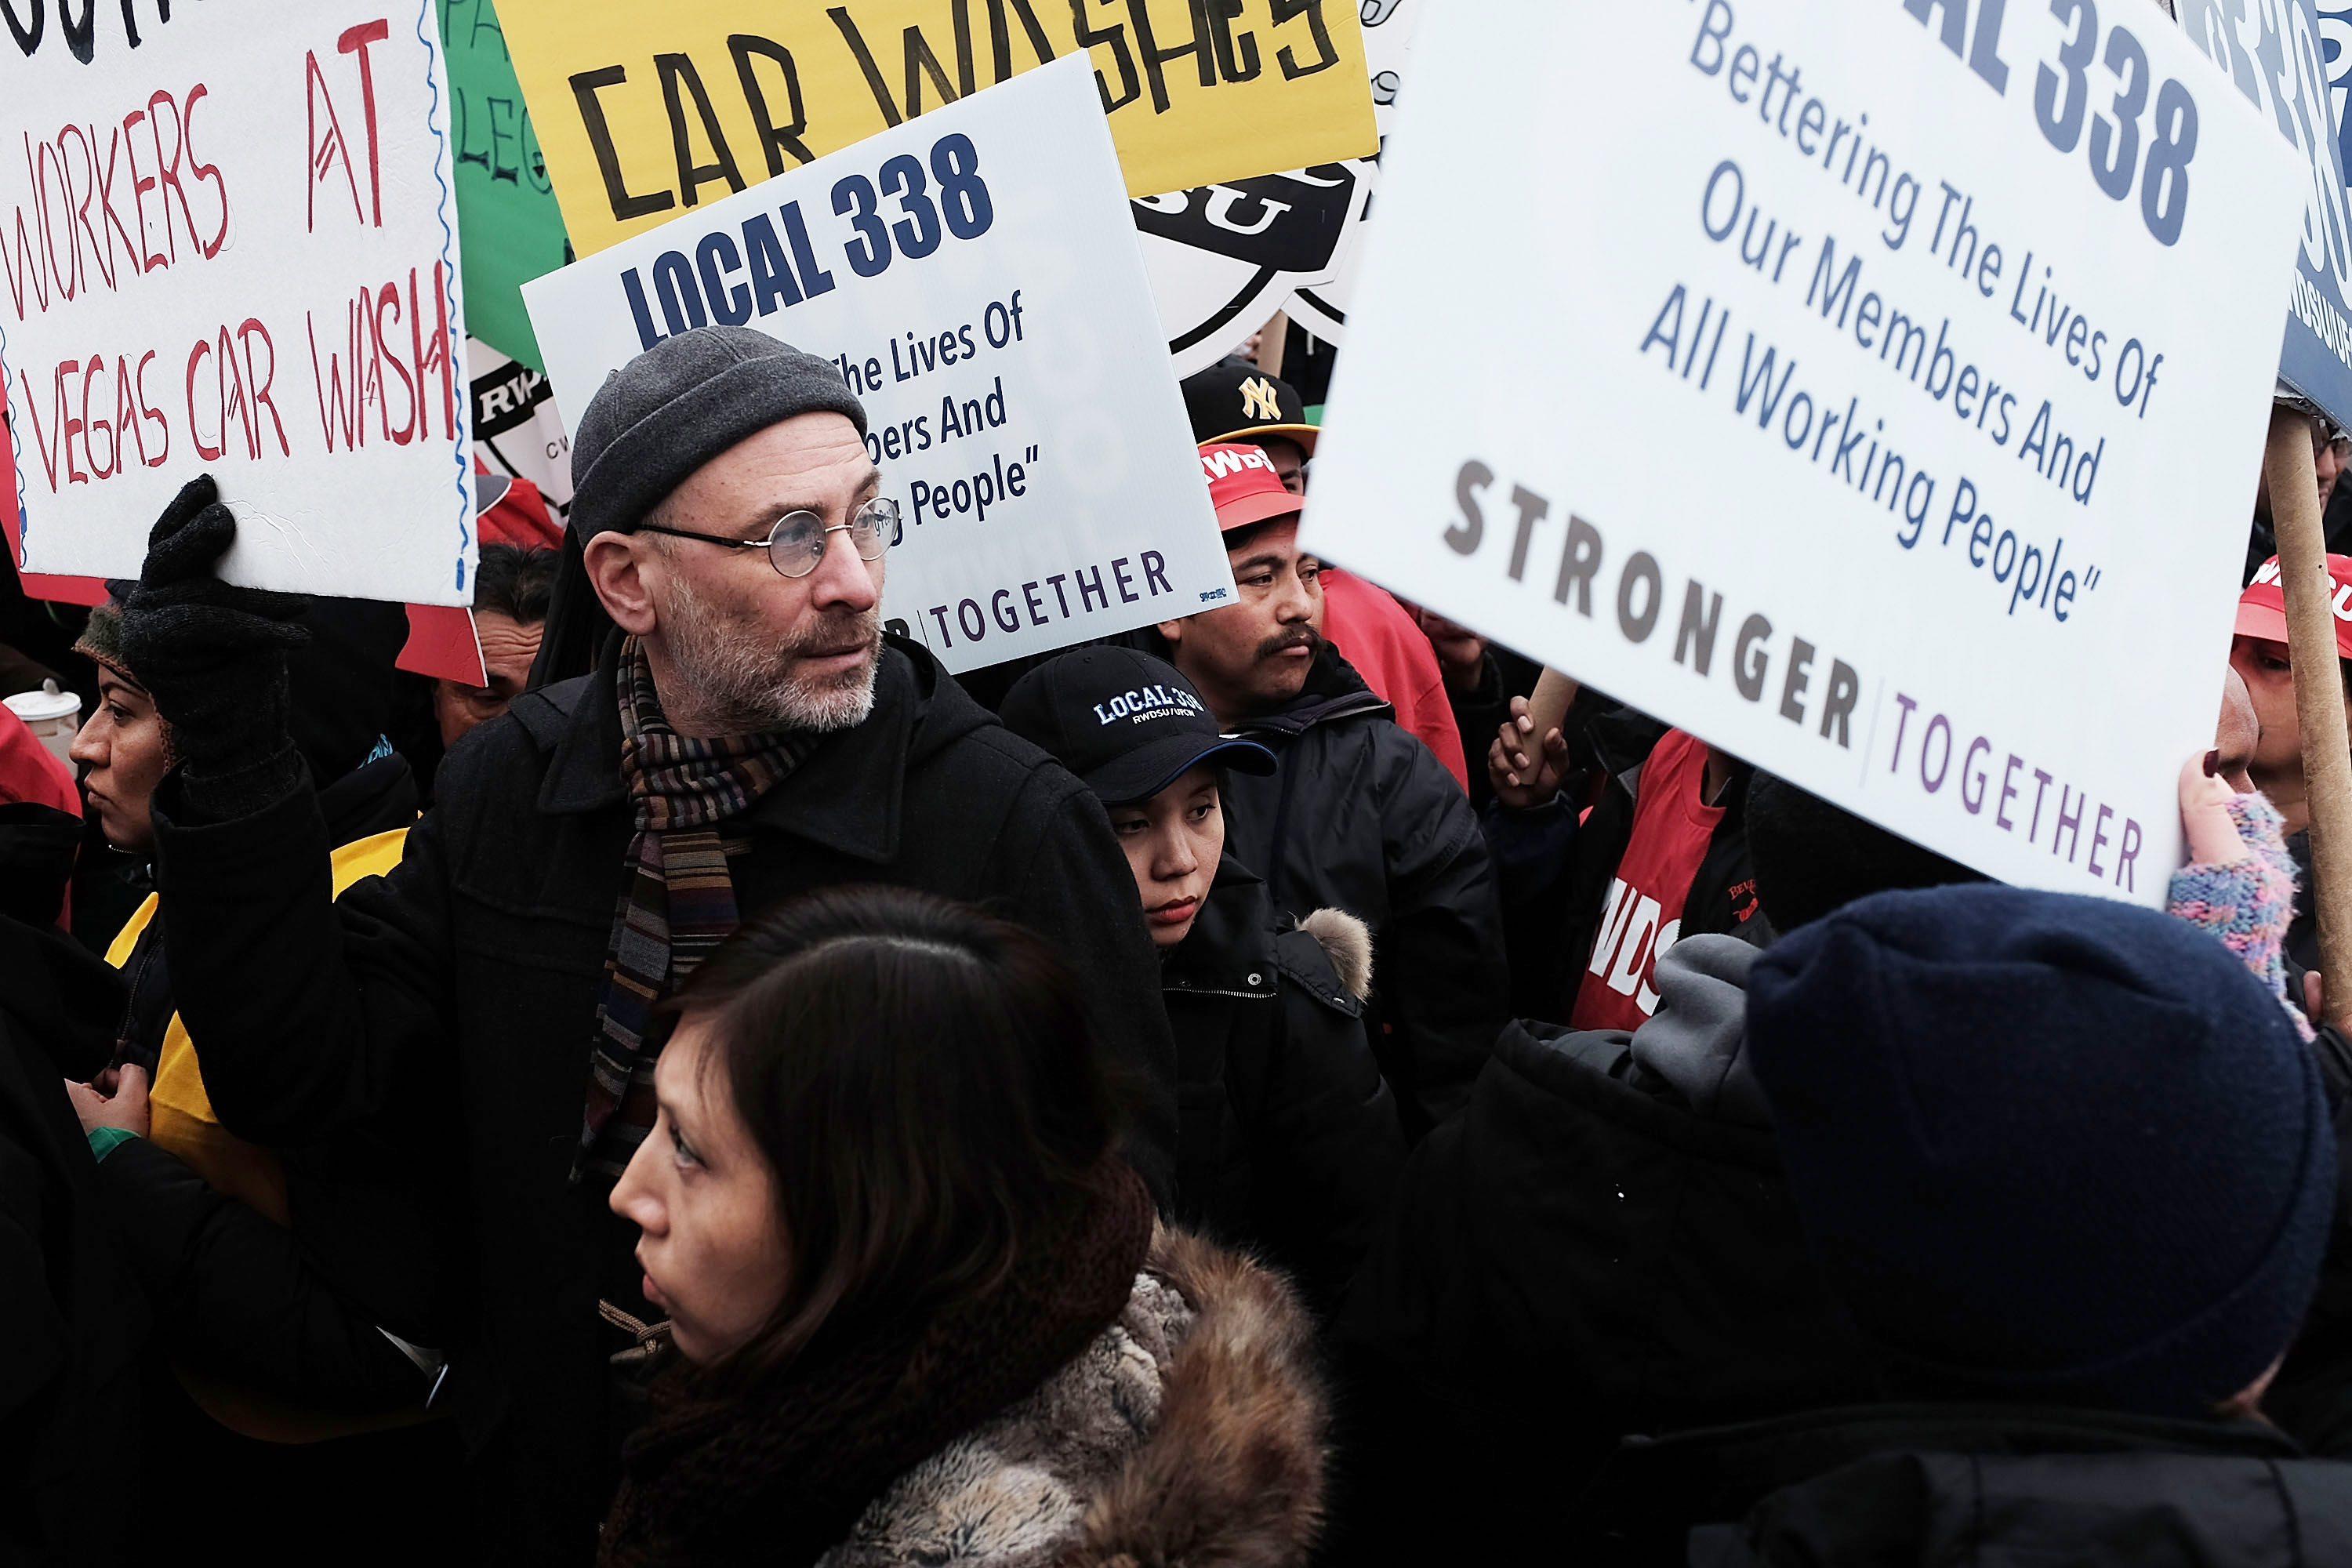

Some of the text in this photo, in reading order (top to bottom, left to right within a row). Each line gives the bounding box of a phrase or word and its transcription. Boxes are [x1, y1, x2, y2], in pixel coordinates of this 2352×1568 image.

[0, 82, 229, 321] WORKERS
[306, 19, 388, 233] AT
[568, 34, 814, 221] CAR
[1689, 0, 1921, 250] Bettering
[1929, 180, 2002, 299] The
[2010, 250, 2109, 383] Lives
[2114, 336, 2166, 421] Of
[620, 133, 993, 352] LOCAL 338
[890, 331, 976, 383] Lives
[983, 289, 1023, 349] Of
[1700, 158, 2105, 506] Our Members And
[21, 260, 455, 494] VEGAS CAR WASH
[940, 376, 1007, 443] And
[1640, 282, 1730, 392] All
[1734, 331, 1936, 550] Working
[929, 550, 1174, 648] TOGETHER
[1094, 684, 1175, 725] LOCAL
[1443, 458, 2143, 894] STRONGER TOGETHER
